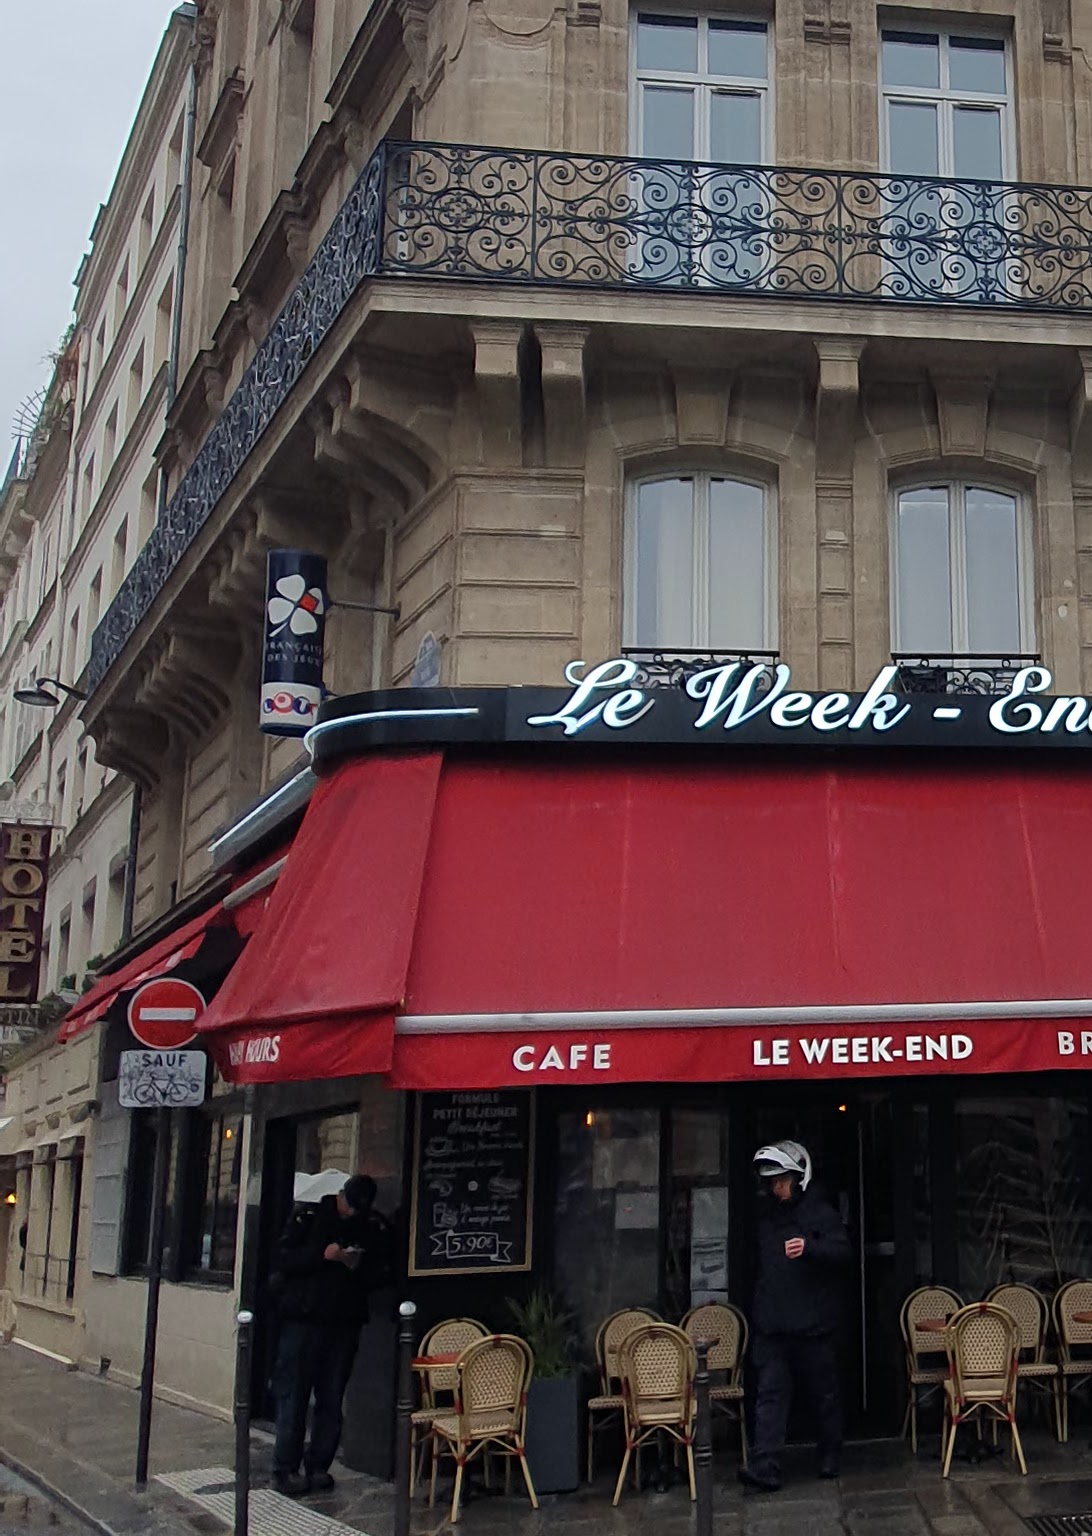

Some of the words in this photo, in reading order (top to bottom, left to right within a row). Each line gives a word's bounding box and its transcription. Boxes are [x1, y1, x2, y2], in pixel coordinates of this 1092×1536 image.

[527, 659, 655, 735] Le
[687, 660, 910, 733] Week
[0, 829, 44, 998] HOTEL
[143, 1054, 188, 1068] SAUF
[513, 1045, 610, 1071] CAFE
[754, 1040, 789, 1065] LE
[799, 1035, 972, 1063] WEEK-END
[452, 1093, 500, 1104] FORMULE
